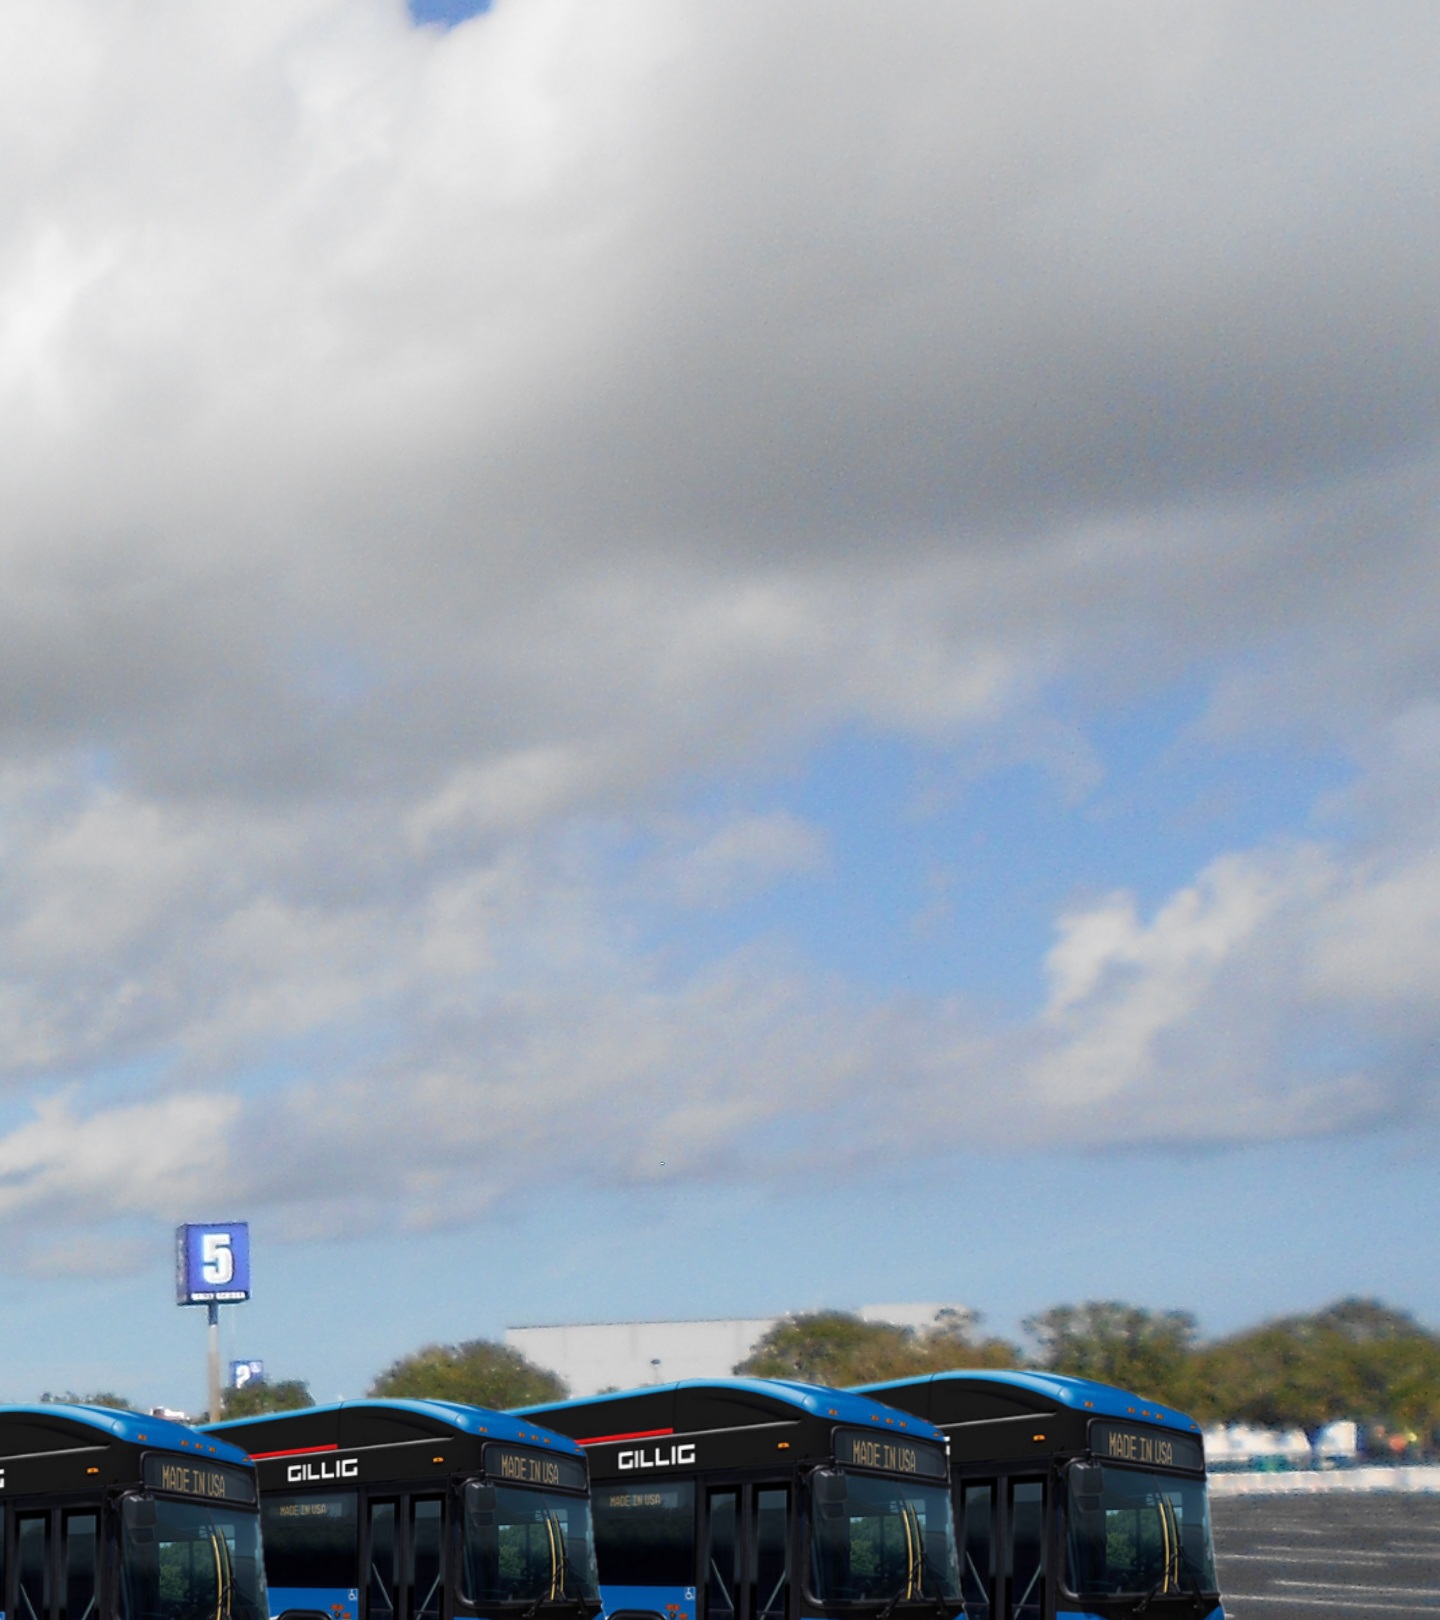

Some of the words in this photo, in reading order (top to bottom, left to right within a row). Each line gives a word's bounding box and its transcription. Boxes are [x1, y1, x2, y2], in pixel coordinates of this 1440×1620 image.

[202, 1233, 234, 1284] 5
[617, 1443, 696, 1470] GILLIG
[853, 1441, 881, 1467] MADE
[884, 1445, 897, 1470] IN
[900, 1449, 915, 1473] USA
[1109, 1434, 1137, 1459] MADE
[1140, 1437, 1153, 1460] IN
[1155, 1441, 1172, 1463] USA
[162, 1466, 190, 1492] MADE
[192, 1470, 206, 1494] IN
[207, 1474, 225, 1496] USA
[287, 1458, 358, 1482] GILLIG
[501, 1455, 527, 1480] MADE
[529, 1459, 541, 1481] IN
[543, 1464, 558, 1485] USA
